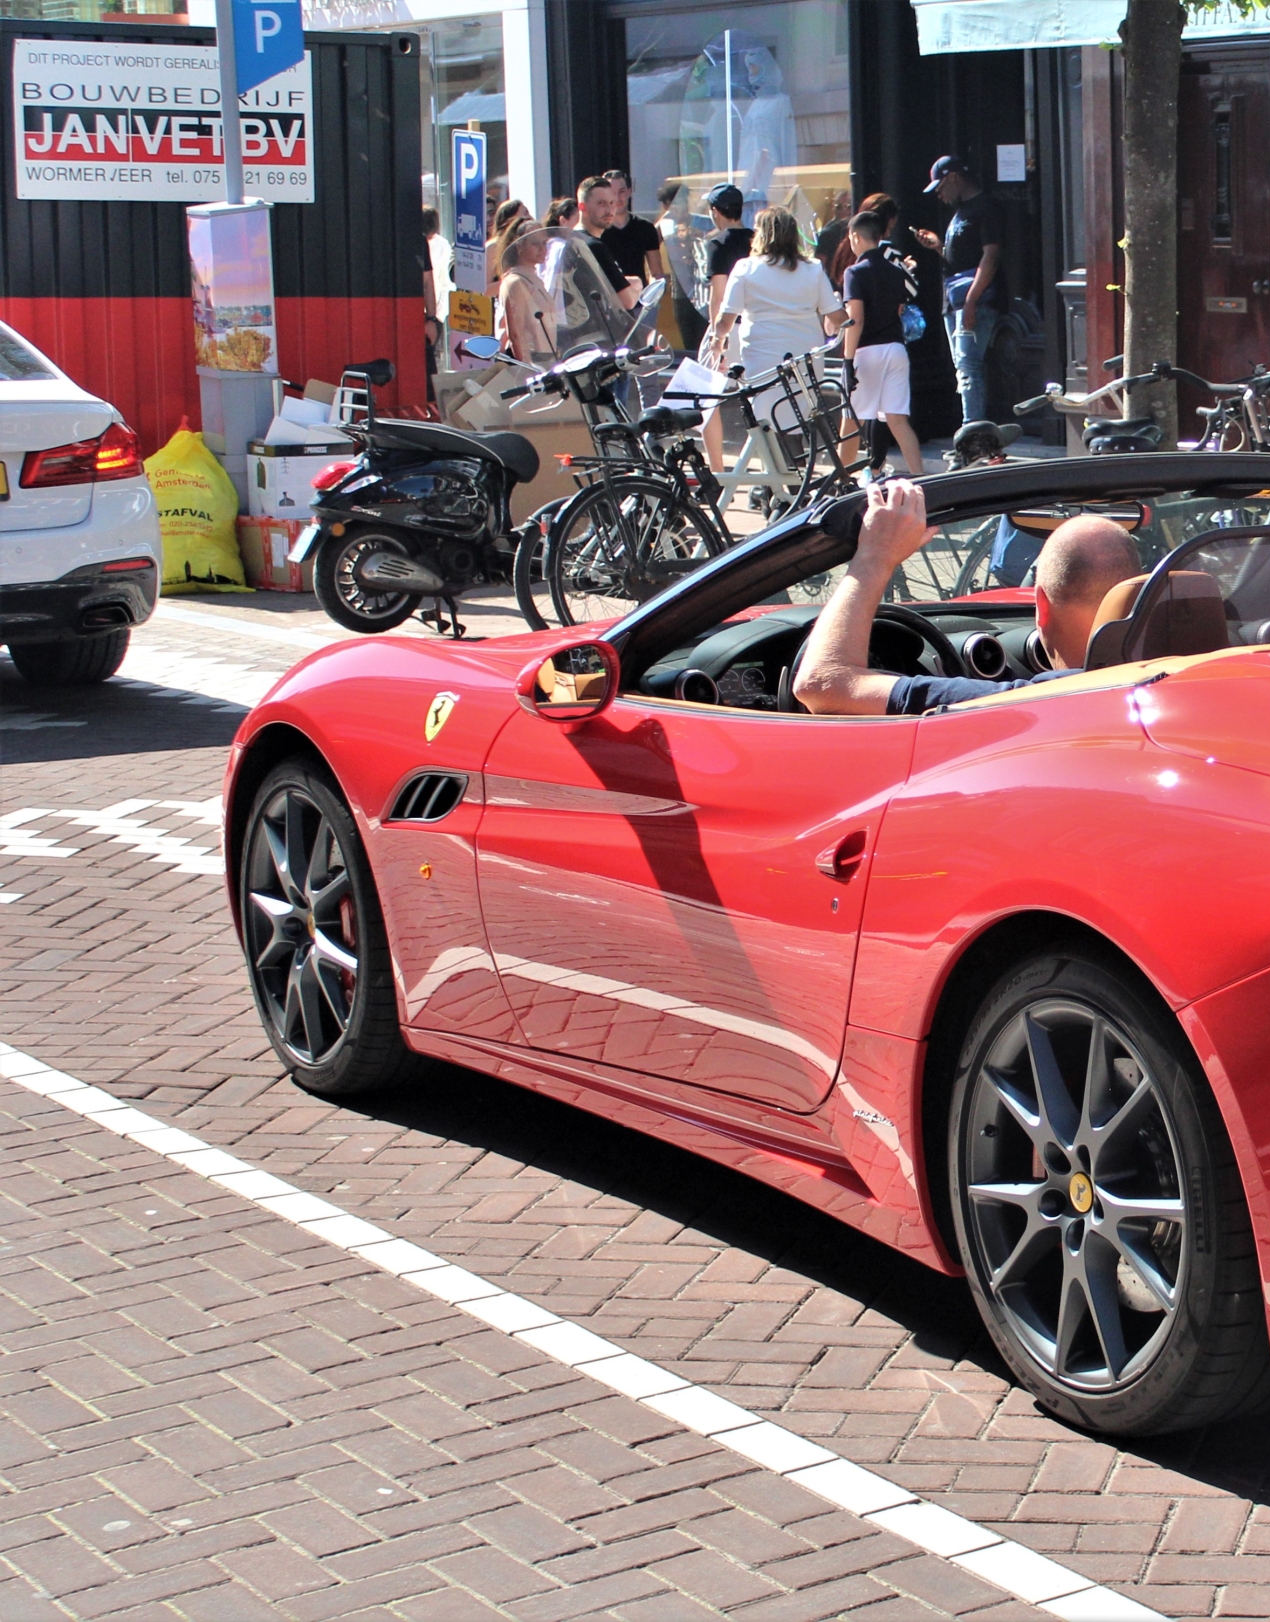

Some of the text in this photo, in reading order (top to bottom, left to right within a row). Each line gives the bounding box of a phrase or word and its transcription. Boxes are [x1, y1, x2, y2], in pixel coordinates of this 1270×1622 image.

[256, 10, 282, 53] P
[28, 52, 48, 65] DIT
[52, 54, 111, 67] PROJECT
[114, 56, 161, 68] WORDT
[27, 112, 128, 154] JAN
[240, 118, 303, 159] BV
[167, 170, 188, 184] tel.
[193, 170, 220, 184] 075
[244, 172, 262, 185] 21
[267, 172, 285, 186] 69
[289, 173, 307, 186] 69
[460, 143, 479, 199] P
